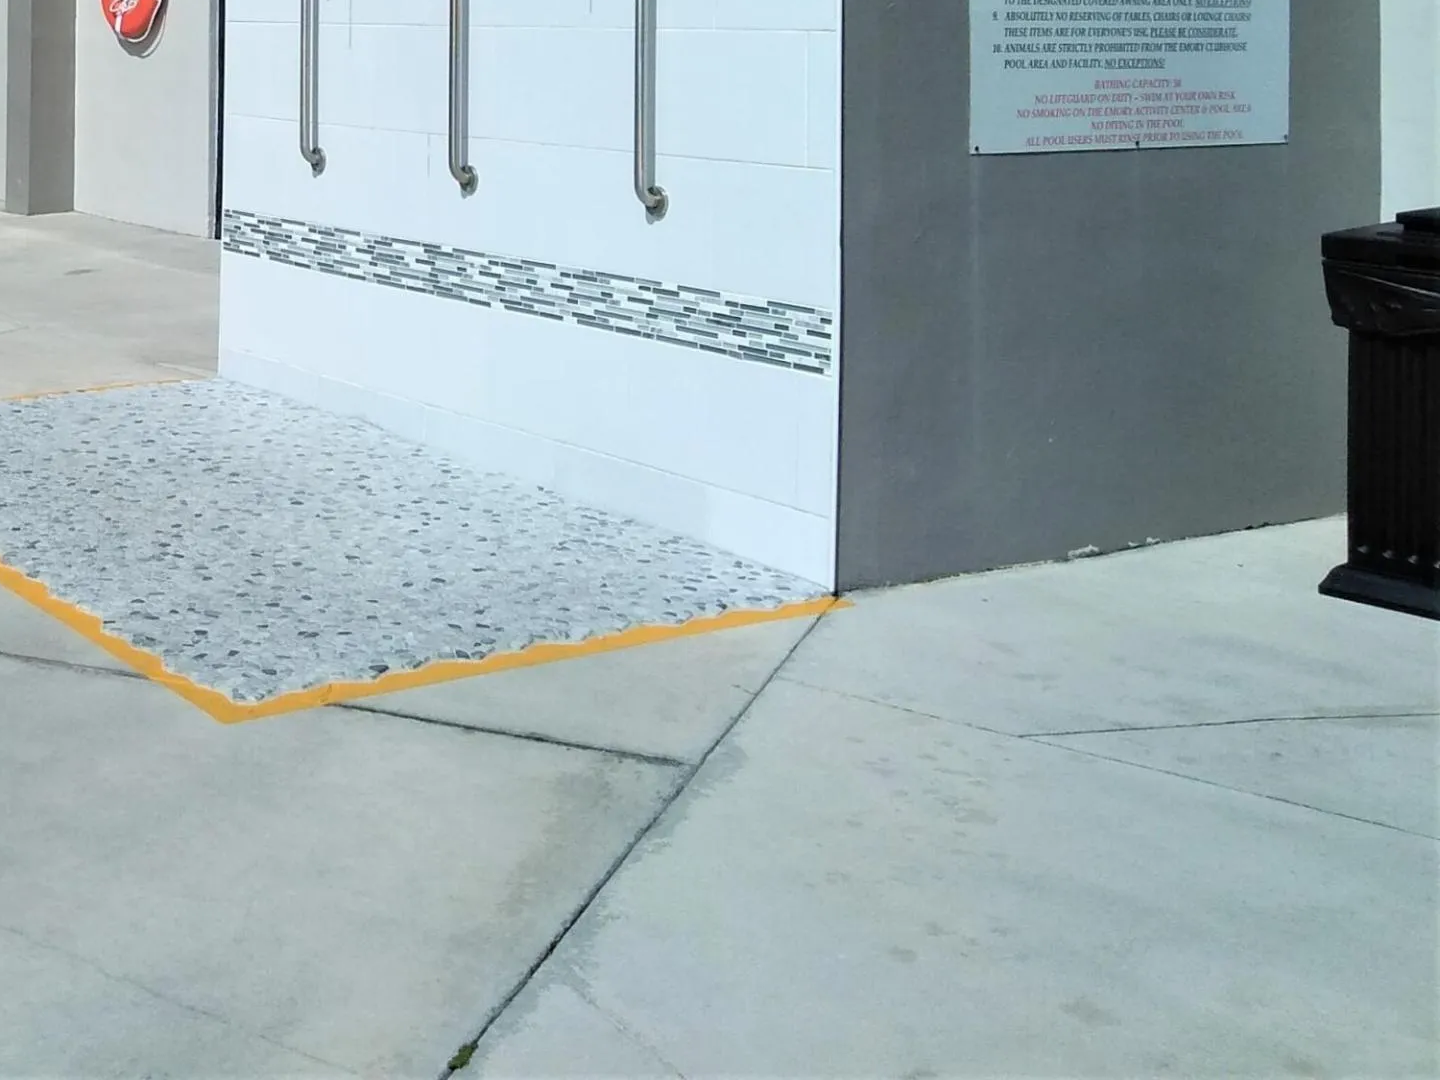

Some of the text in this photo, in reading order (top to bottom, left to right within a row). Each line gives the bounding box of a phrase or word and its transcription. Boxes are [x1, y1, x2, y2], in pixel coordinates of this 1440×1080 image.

[1055, 11, 1067, 20] NO
[1004, 27, 1027, 37] THESE
[1029, 27, 1052, 37] ITEMS
[1055, 27, 1069, 37] ARE
[1071, 27, 1085, 37] FOR
[1004, 43, 1040, 52] ANIMALS
[1042, 43, 1057, 52] ARE
[1004, 59, 1026, 69] POOL
[1028, 59, 1048, 68] AREA
[1051, 58, 1068, 68] AND
